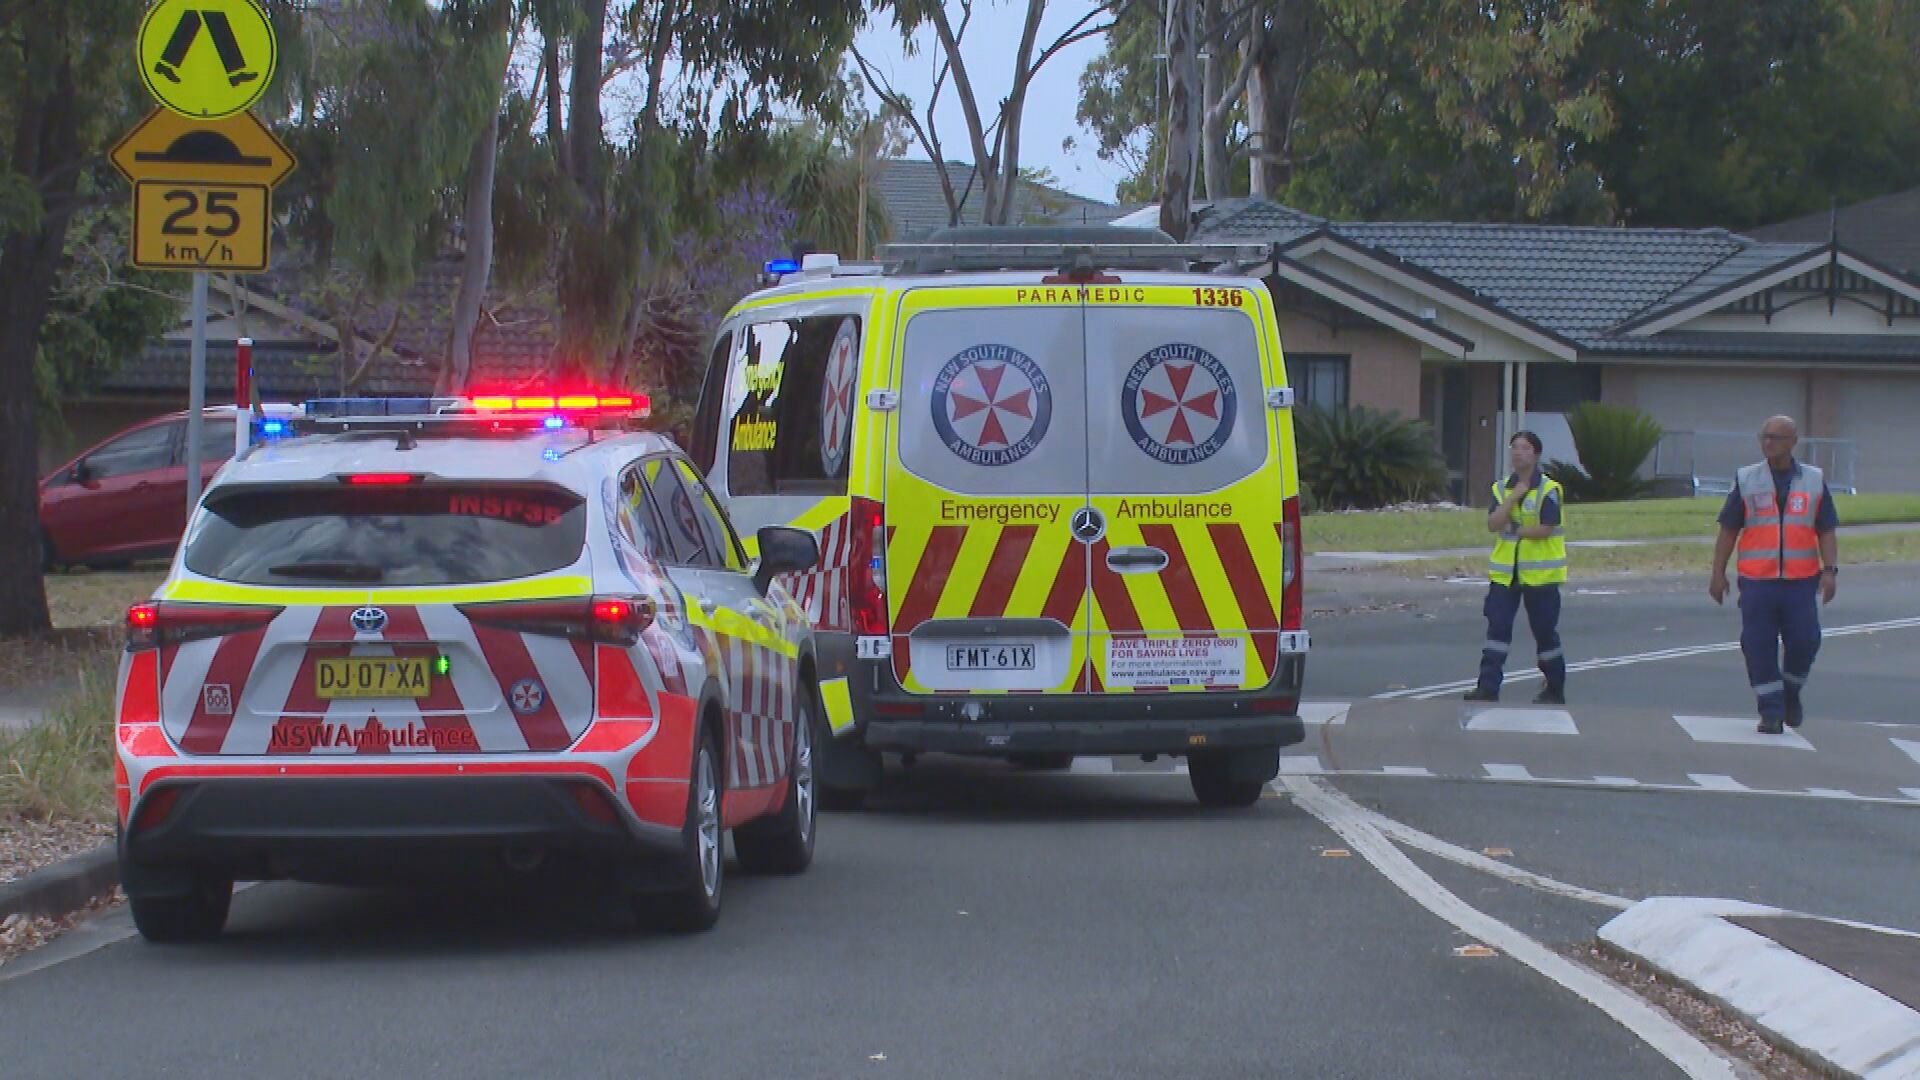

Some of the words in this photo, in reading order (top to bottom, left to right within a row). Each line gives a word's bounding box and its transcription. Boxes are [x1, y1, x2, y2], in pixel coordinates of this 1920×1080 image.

[161, 190, 240, 236] 25
[164, 240, 233, 262] km/h
[1017, 289, 1145, 302] PARAMEDIC
[1193, 288, 1243, 306] 1336
[936, 359, 961, 392] NEW
[961, 346, 1009, 365] SOUTH
[1011, 351, 1048, 392] WALES
[1127, 359, 1151, 390] NEW
[1150, 345, 1197, 364] SOUTH
[1200, 351, 1233, 395] WALES
[949, 438, 1036, 465] AMBULANCE
[1138, 438, 1221, 463] AMBULANCE
[941, 500, 1060, 523] Emergency
[1117, 500, 1232, 518] Ambulance
[1112, 640, 1139, 648] SAVE
[1143, 640, 1179, 648] TRIPLE
[1182, 639, 1211, 648] ZERO
[1112, 649, 1134, 658] FOR
[1137, 649, 1176, 657] SAVING
[1179, 648, 1208, 657] LIVES
[1112, 660, 1126, 668] For
